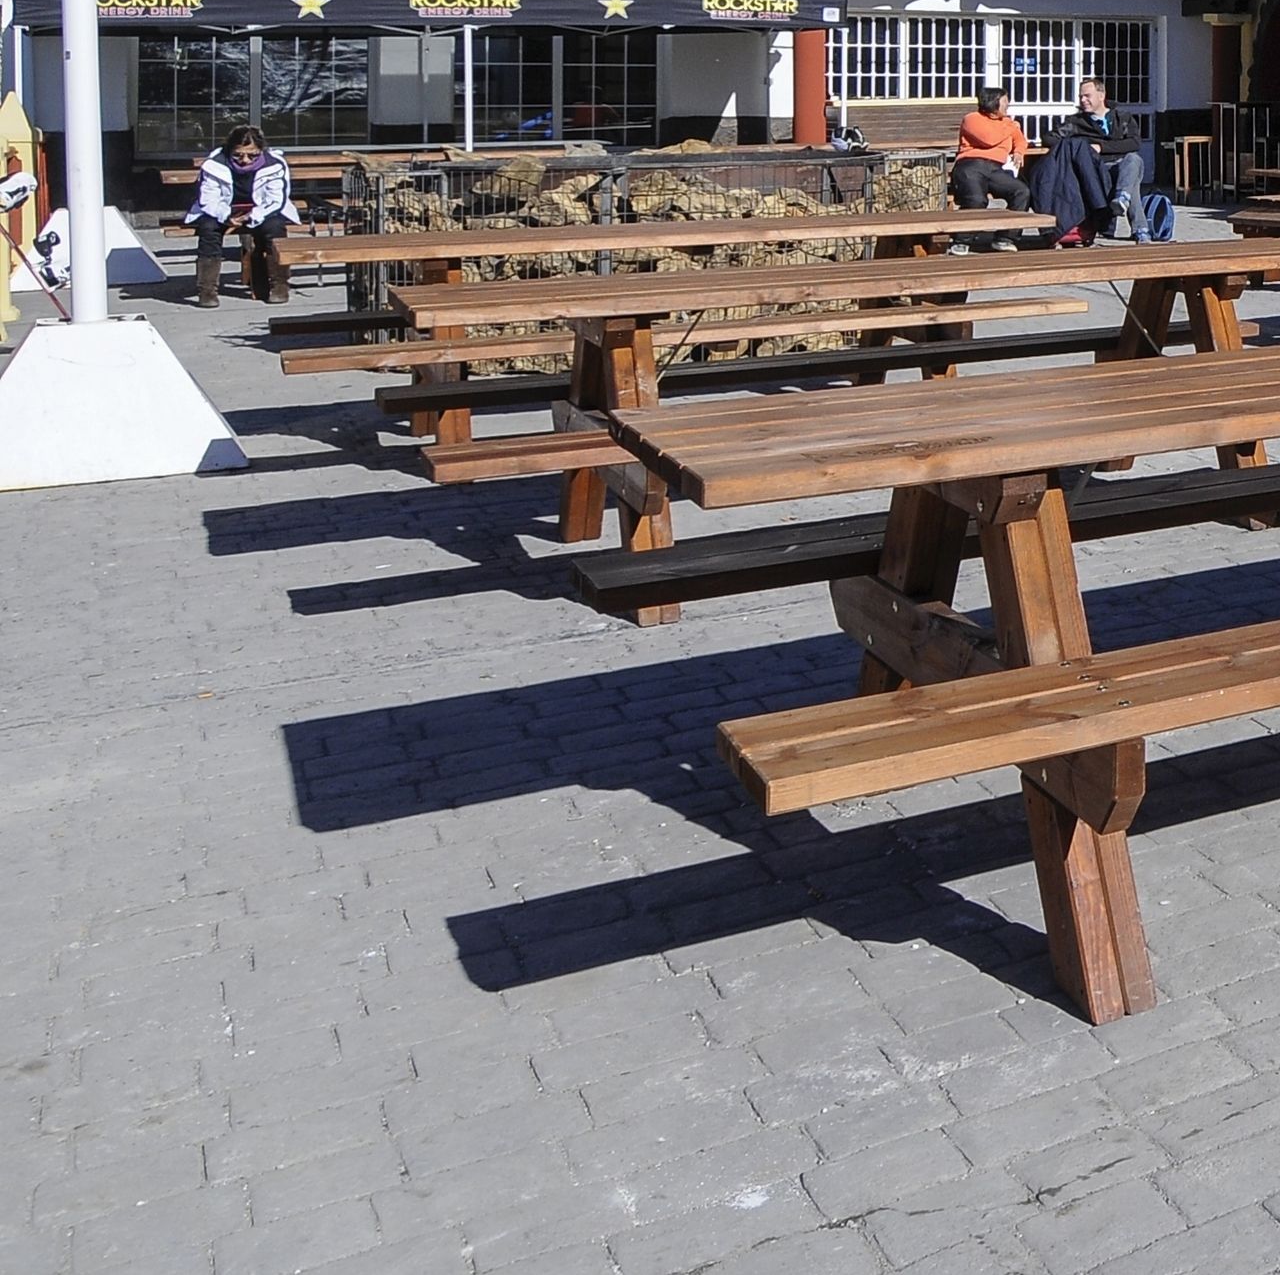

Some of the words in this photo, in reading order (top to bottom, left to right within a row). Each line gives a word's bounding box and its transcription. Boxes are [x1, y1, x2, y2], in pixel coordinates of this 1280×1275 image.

[98, 7, 146, 16] NERGY
[150, 7, 191, 16] DRINK
[420, 7, 468, 17] ENERGY
[473, 7, 511, 17] DRINK
[712, 9, 753, 19] ENERGY
